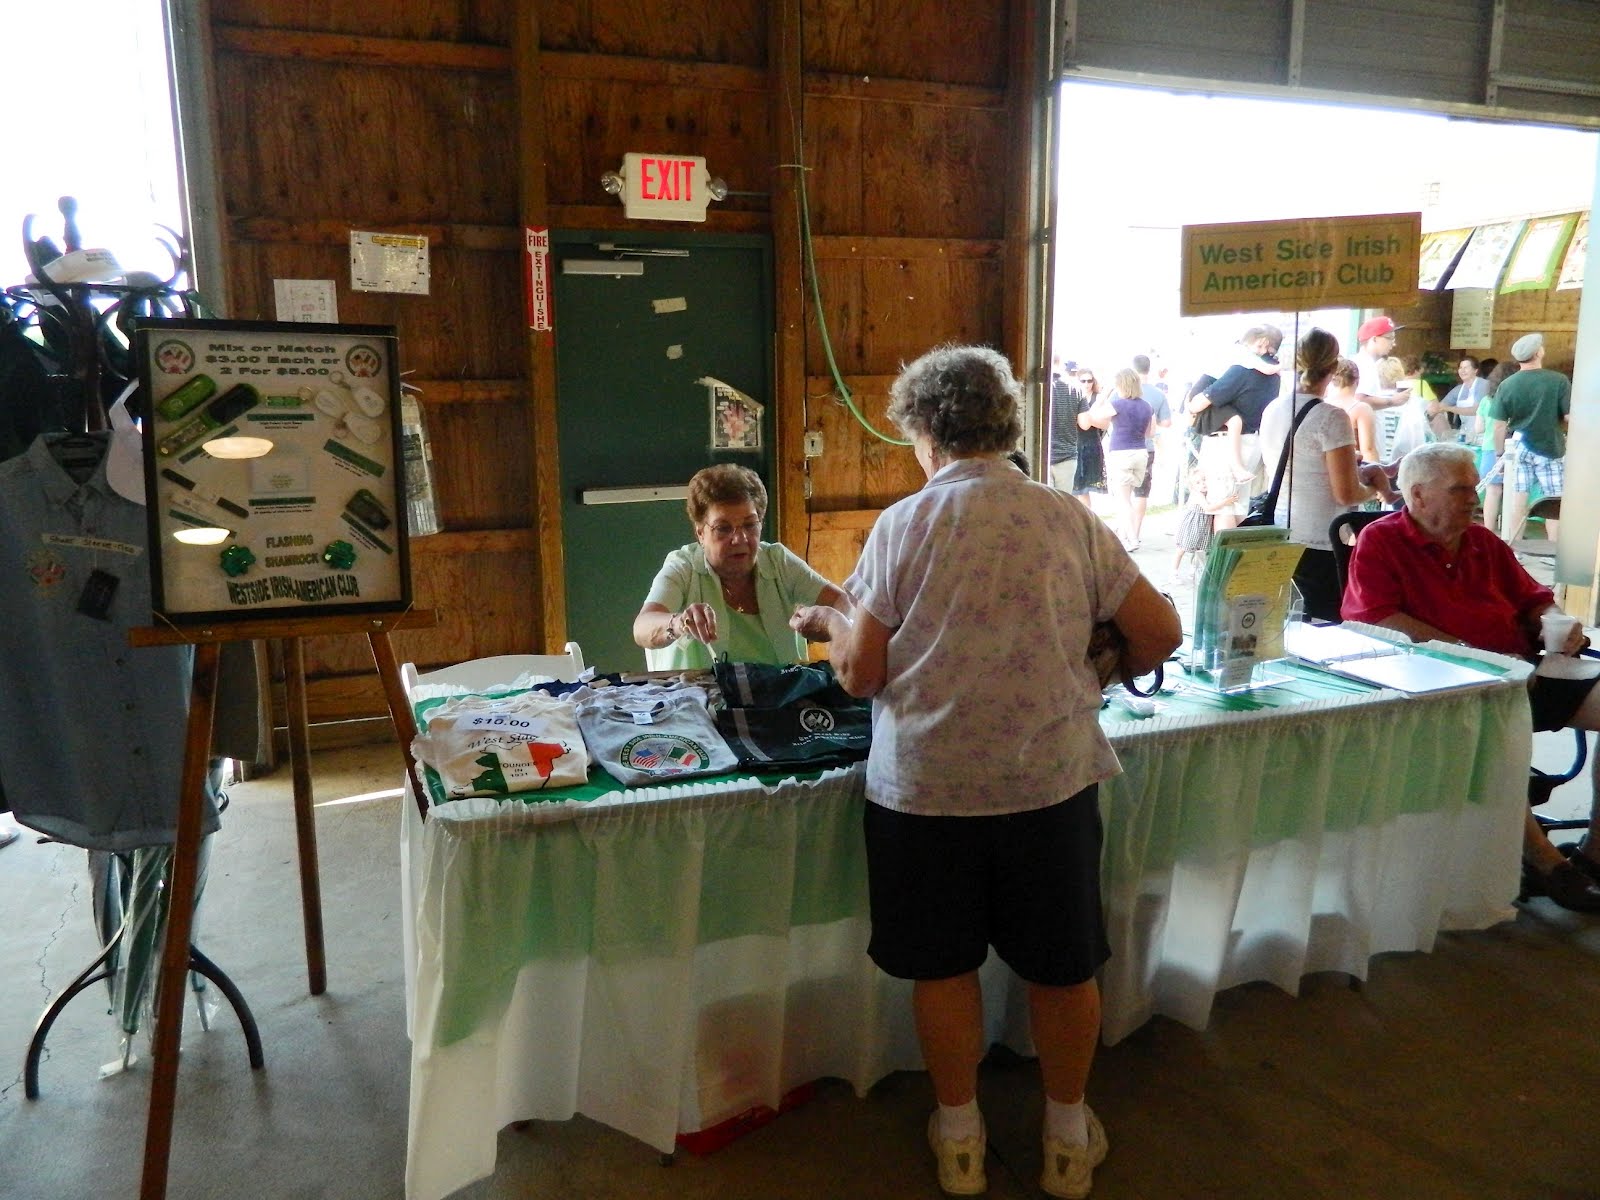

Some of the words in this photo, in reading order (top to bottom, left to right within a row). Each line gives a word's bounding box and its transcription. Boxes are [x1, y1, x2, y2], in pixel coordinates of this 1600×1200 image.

[641, 158, 696, 201] EXIT
[528, 235, 548, 247] FIRE
[1199, 243, 1264, 265] West
[1276, 239, 1334, 262] Side
[1346, 235, 1401, 257] Irish
[1203, 268, 1325, 292] American
[1336, 262, 1394, 286] Club
[208, 344, 245, 352] Mix
[277, 345, 336, 353] Match
[205, 355, 261, 363] $3.00
[267, 356, 315, 364] Each
[220, 367, 232, 375] 2
[238, 367, 271, 375] For
[276, 367, 330, 376] $5.00
[265, 534, 314, 549] FLASHING
[264, 553, 320, 568] SHAMROCK
[336, 574, 360, 598] CLUB
[472, 717, 530, 728] $10.00
[467, 736, 504, 750] West
